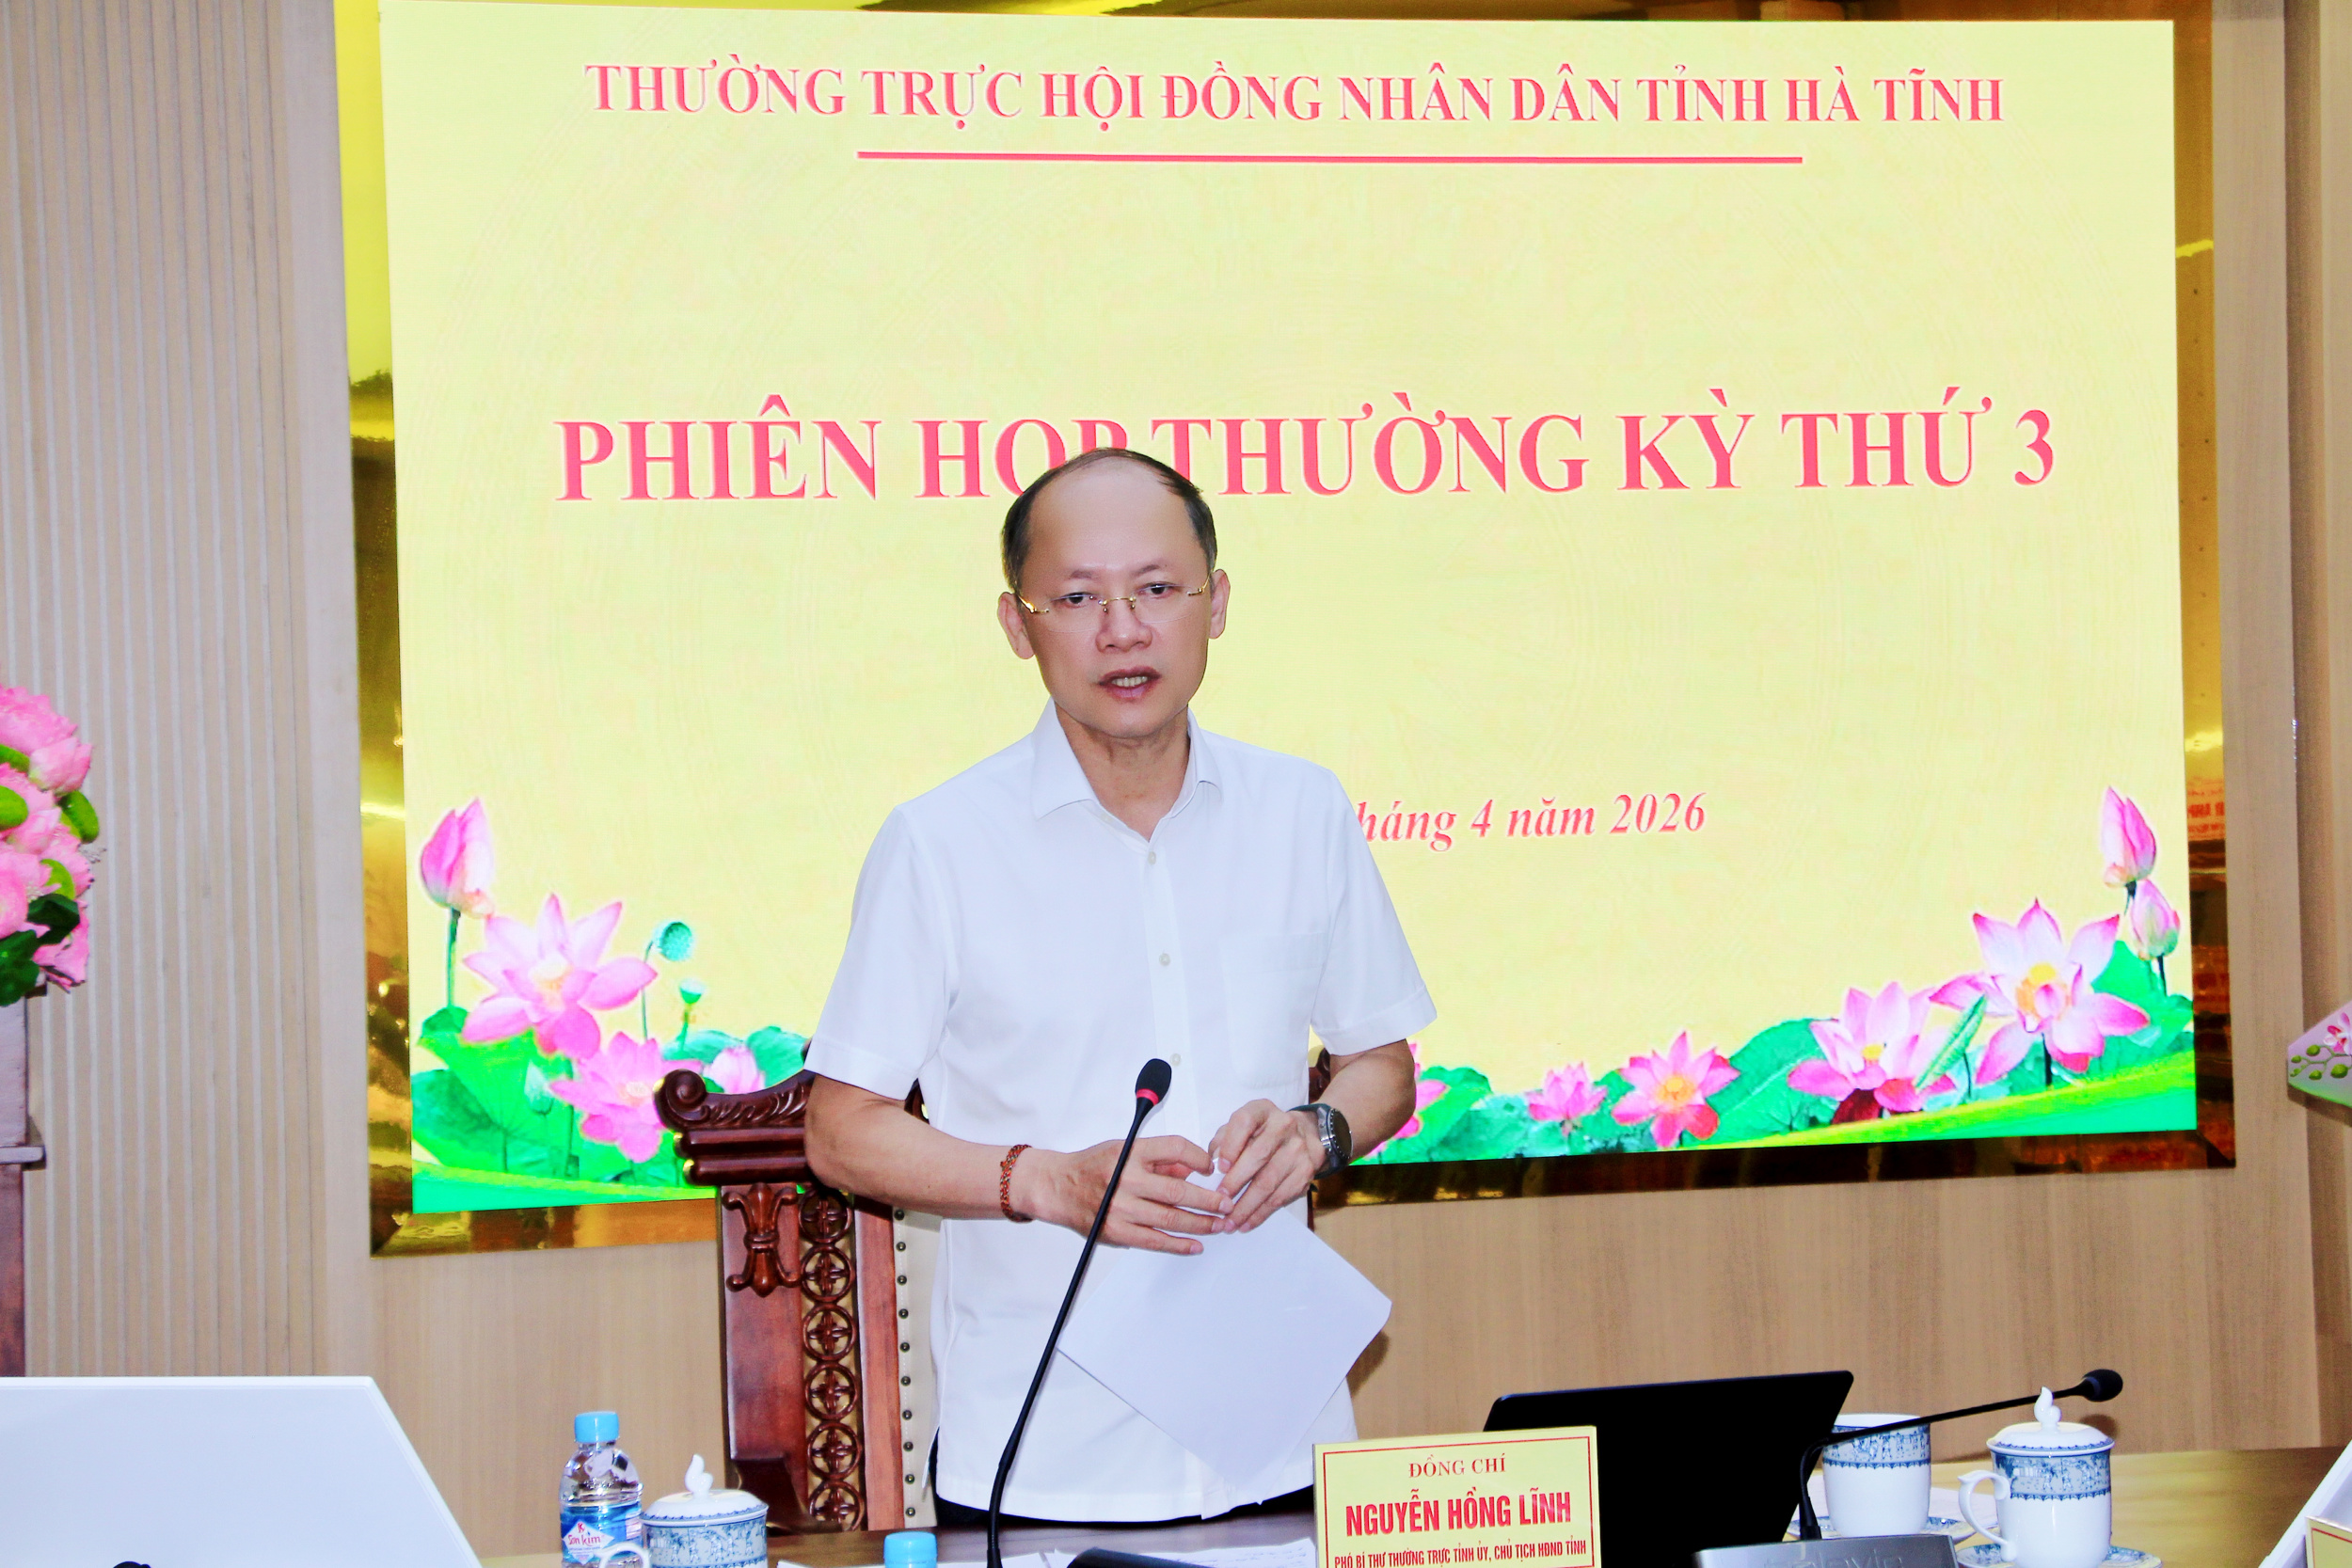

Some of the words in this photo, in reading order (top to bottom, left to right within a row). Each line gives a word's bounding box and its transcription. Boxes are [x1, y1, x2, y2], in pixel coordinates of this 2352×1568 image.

[585, 53, 845, 116] THƯỜNG
[861, 63, 1023, 131] TRỰC
[1041, 65, 1144, 133] HỘI
[1162, 59, 1322, 122] ĐỒNG
[1339, 61, 1492, 121] NHÂN
[1511, 62, 1620, 122] DÂN
[1635, 63, 1767, 122] TỈNH
[1785, 64, 1860, 122] HÀ
[1872, 67, 2002, 122] TĨNH
[556, 393, 882, 501] PHIÊN
[1151, 390, 1590, 497] THƯỜNG
[1616, 387, 1756, 491] KỲ
[1780, 385, 1994, 489] THỨ
[2013, 408, 2055, 487] 3
[1358, 800, 1456, 851] háng
[1470, 798, 1493, 837] 4
[1508, 797, 1595, 837] năm
[1611, 793, 1707, 834] 2026
[1408, 1454, 1466, 1478] ĐỒNG
[1471, 1453, 1506, 1474] CHÍ
[1345, 1488, 1440, 1537] NGUYỄN
[1447, 1485, 1512, 1530] HỒNG
[1518, 1486, 1571, 1526] LĨNH
[1368, 1551, 1386, 1568] THƯ
[1389, 1546, 1424, 1567] THƯỜNG
[1427, 1547, 1451, 1568] TRỰC
[1453, 1542, 1474, 1563] TỈNH
[1476, 1539, 1492, 1563] ỦY,
[1494, 1538, 1513, 1560] CHỦ
[1515, 1543, 1535, 1562] TỊCH
[1537, 1541, 1563, 1558] HĐND
[1565, 1534, 1586, 1556] TỈNH
